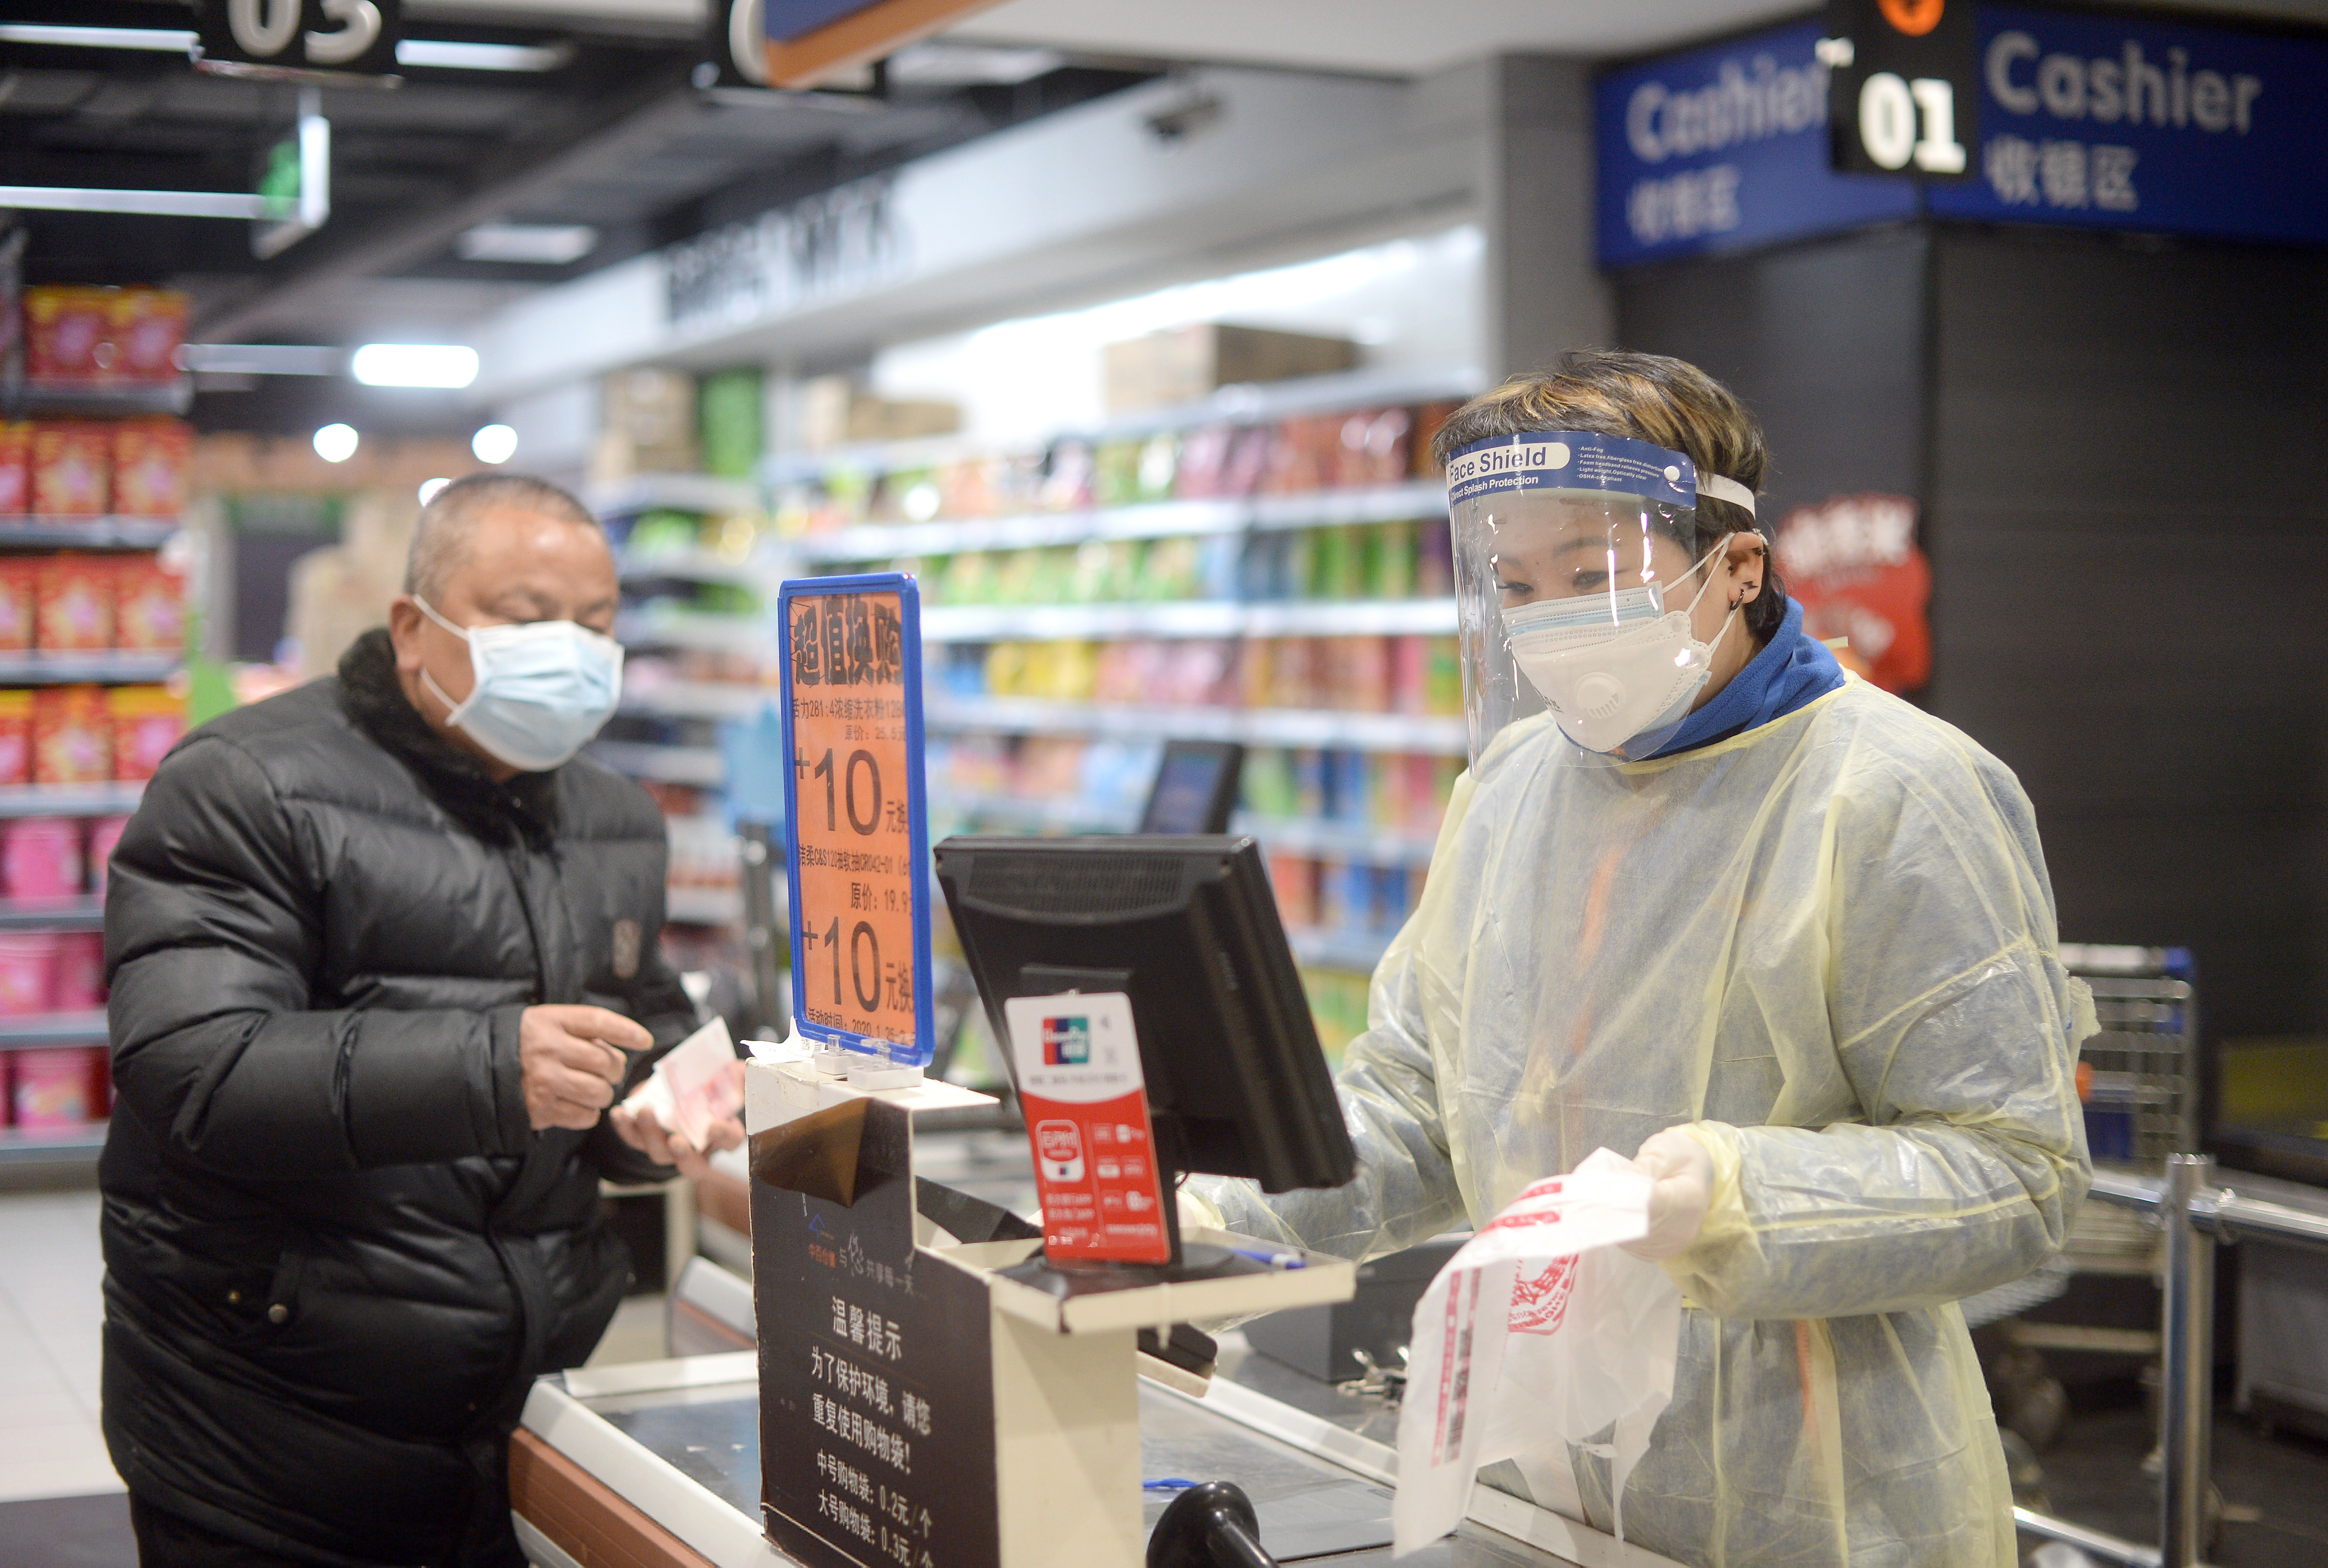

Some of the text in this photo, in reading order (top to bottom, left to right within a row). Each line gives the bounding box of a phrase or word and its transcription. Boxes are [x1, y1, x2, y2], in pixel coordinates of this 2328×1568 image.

[1984, 30, 2262, 135] Cashier
[1859, 72, 1966, 174] 01
[1450, 447, 1546, 485] Face Shield
[1464, 481, 1487, 496] Splash
[1489, 475, 1539, 489] Protection
[832, 1295, 902, 1361] 温馨提示
